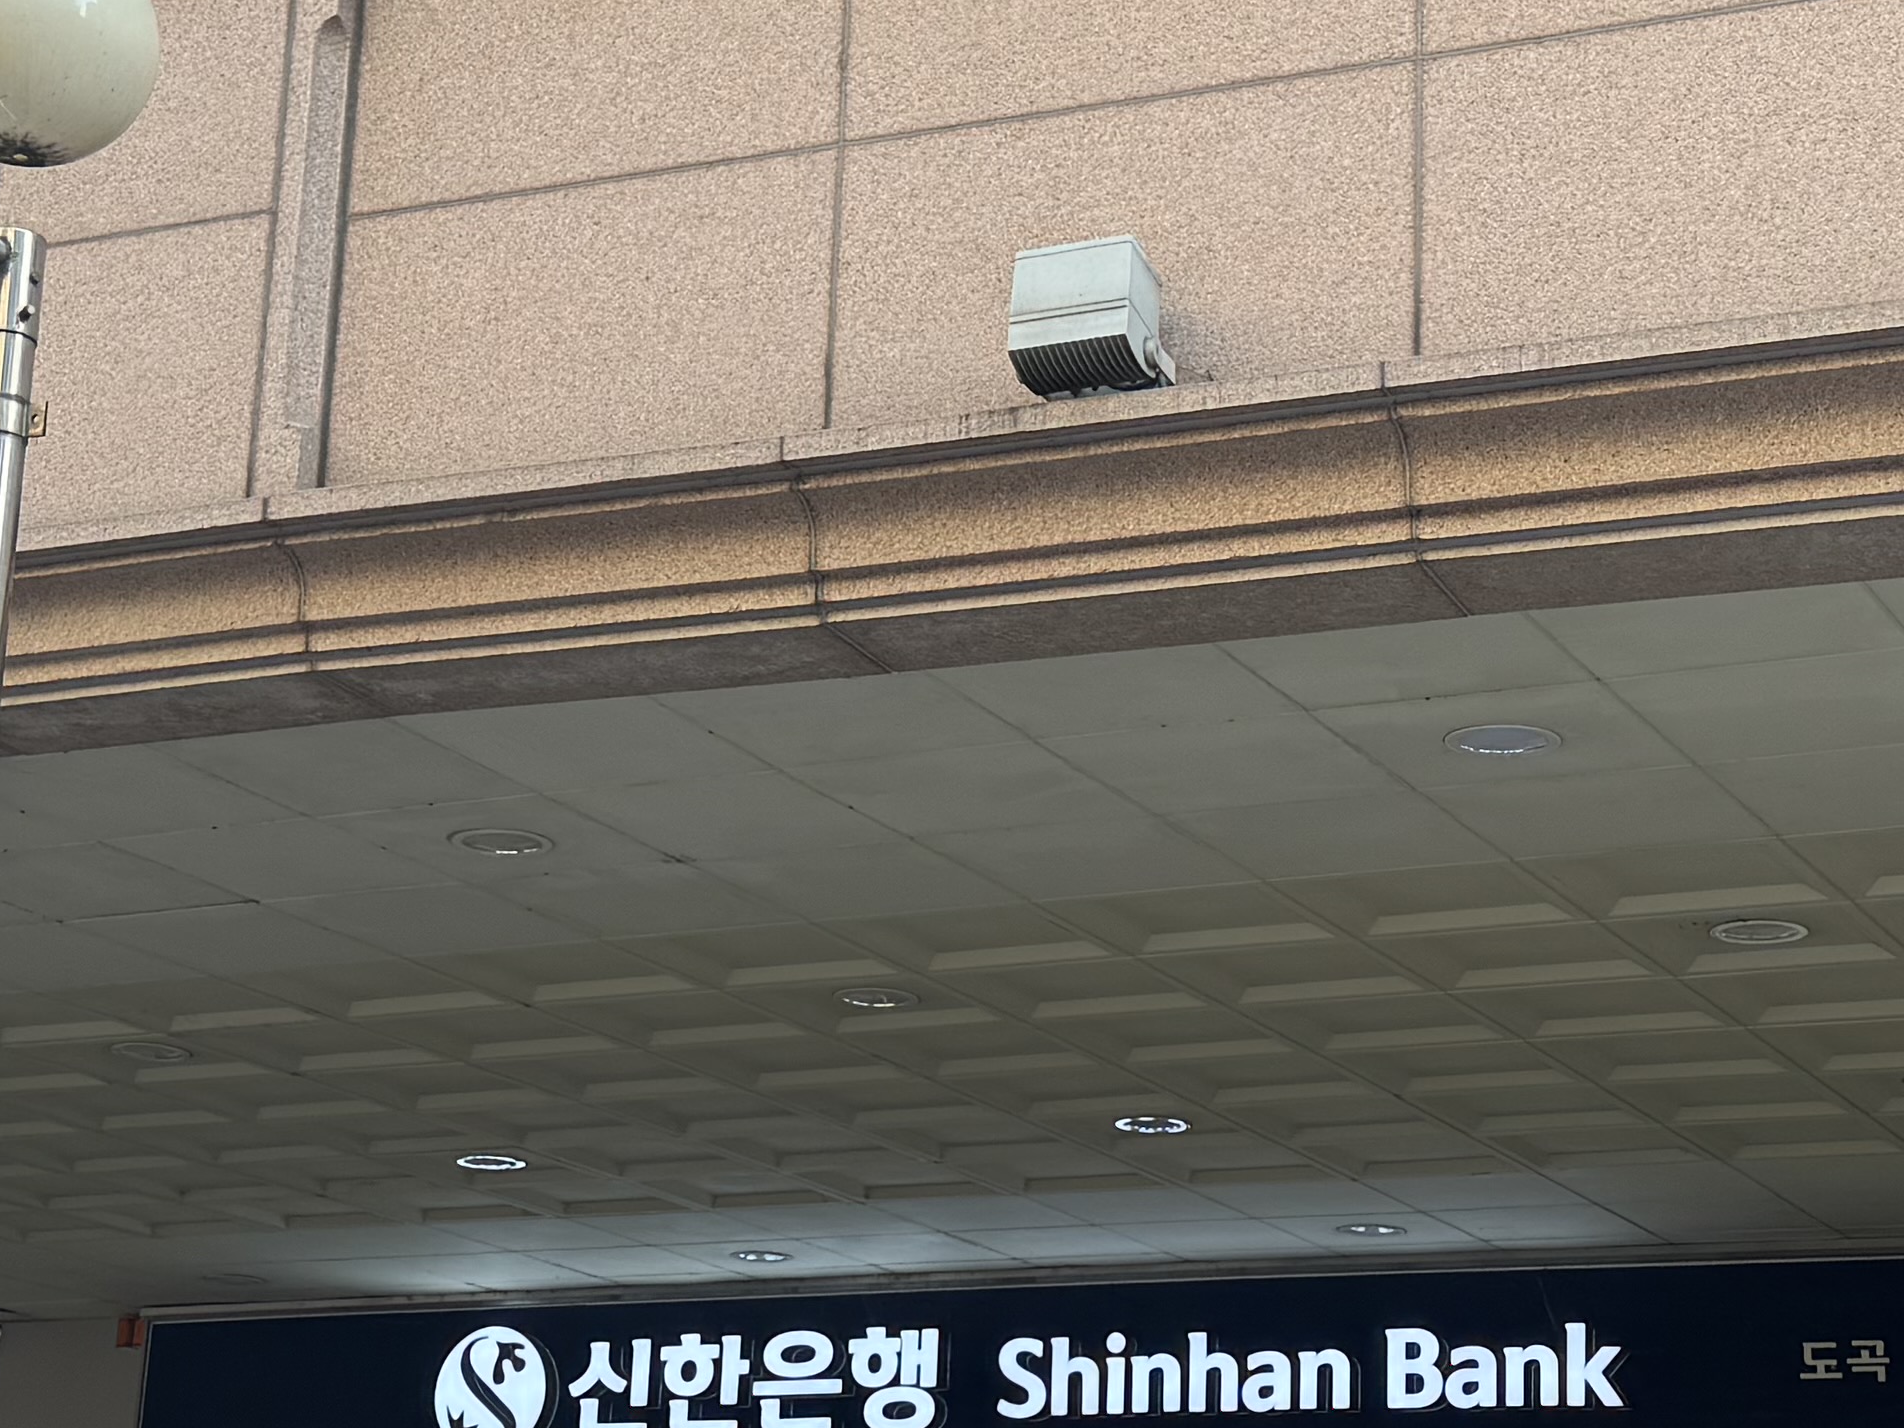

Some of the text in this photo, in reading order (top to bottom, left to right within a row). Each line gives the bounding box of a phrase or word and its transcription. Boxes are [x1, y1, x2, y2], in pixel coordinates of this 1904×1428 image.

[995, 1334, 1353, 1419] Shinhan
[1383, 1321, 1626, 1411] Bank
[1795, 1338, 1892, 1388] 도곡
